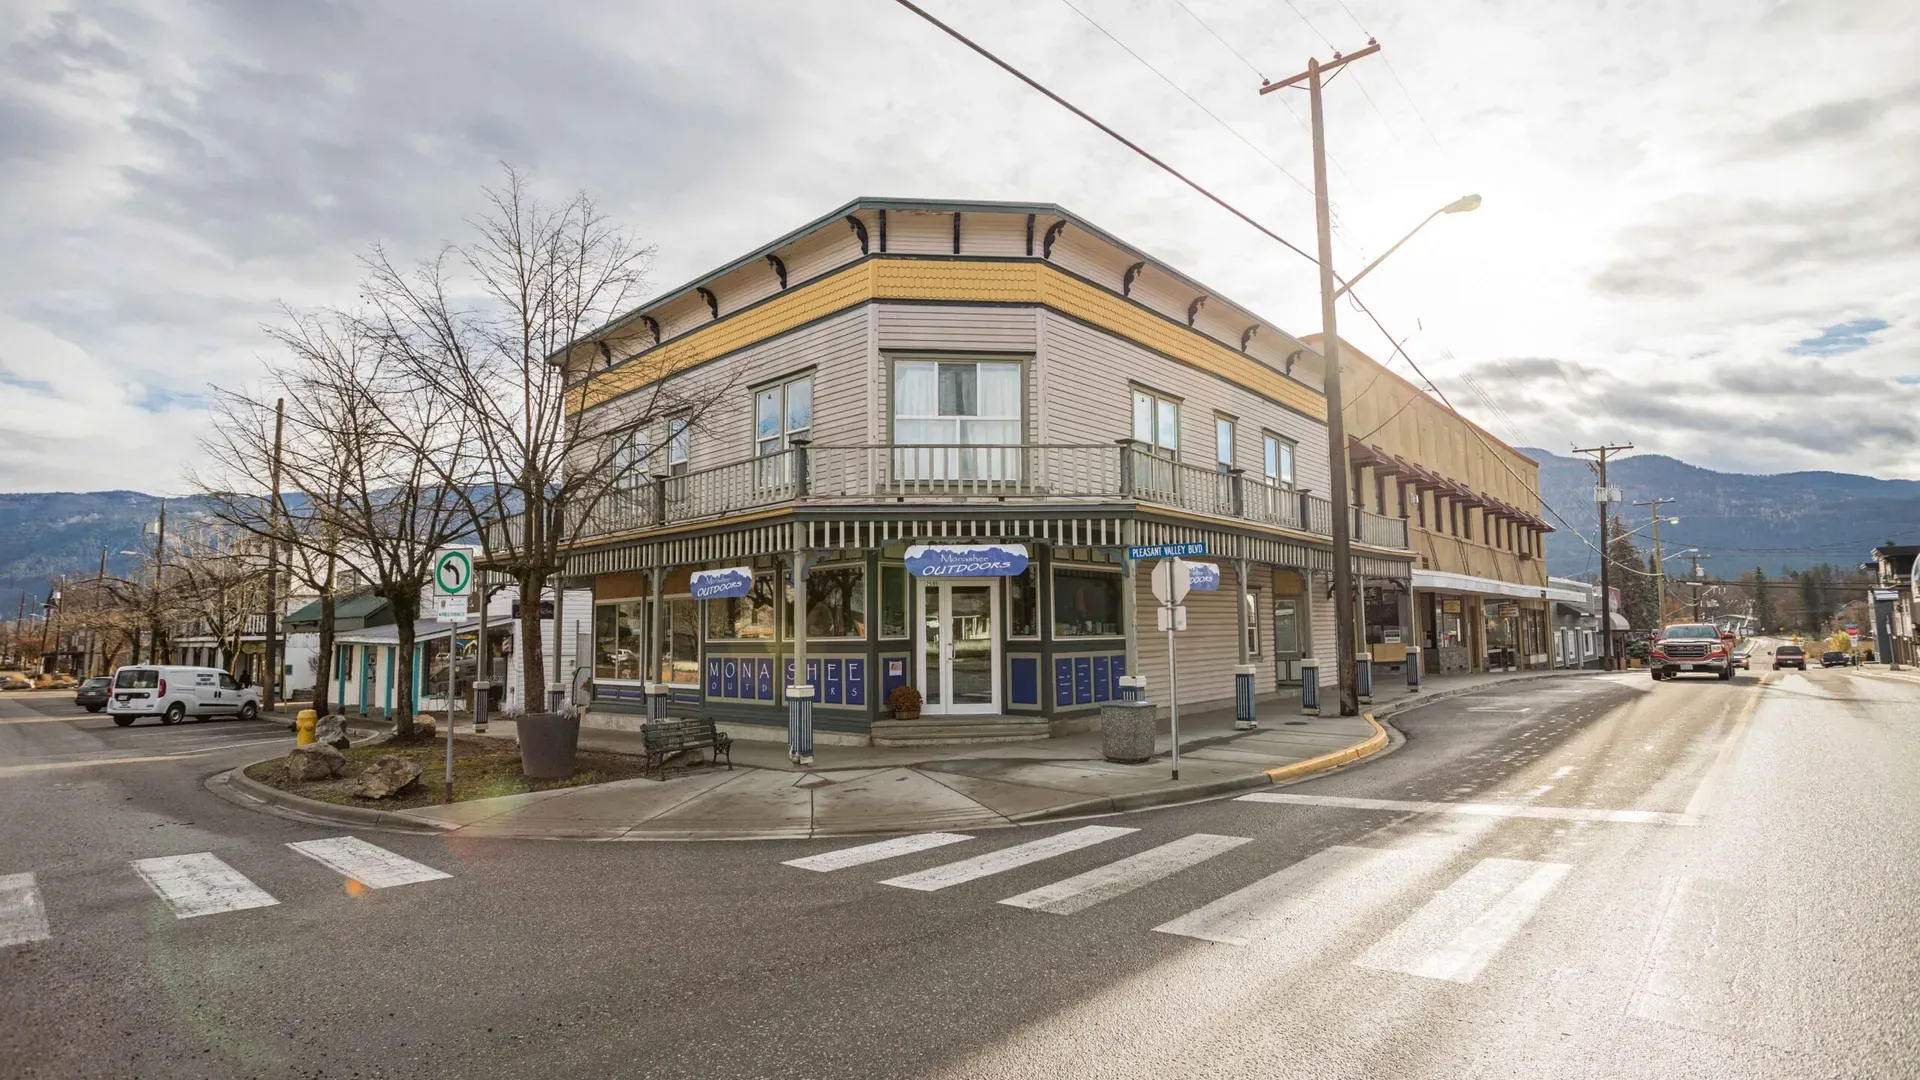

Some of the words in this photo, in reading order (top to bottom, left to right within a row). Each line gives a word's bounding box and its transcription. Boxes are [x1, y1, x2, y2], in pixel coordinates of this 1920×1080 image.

[1132, 547, 1161, 557] PLEASANT
[1164, 546, 1185, 555] VALLEY
[1188, 544, 1203, 553] BLVD
[941, 554, 989, 563] Monashee
[923, 562, 1011, 576] OUTDOORS
[697, 581, 742, 597] OUTDOORS
